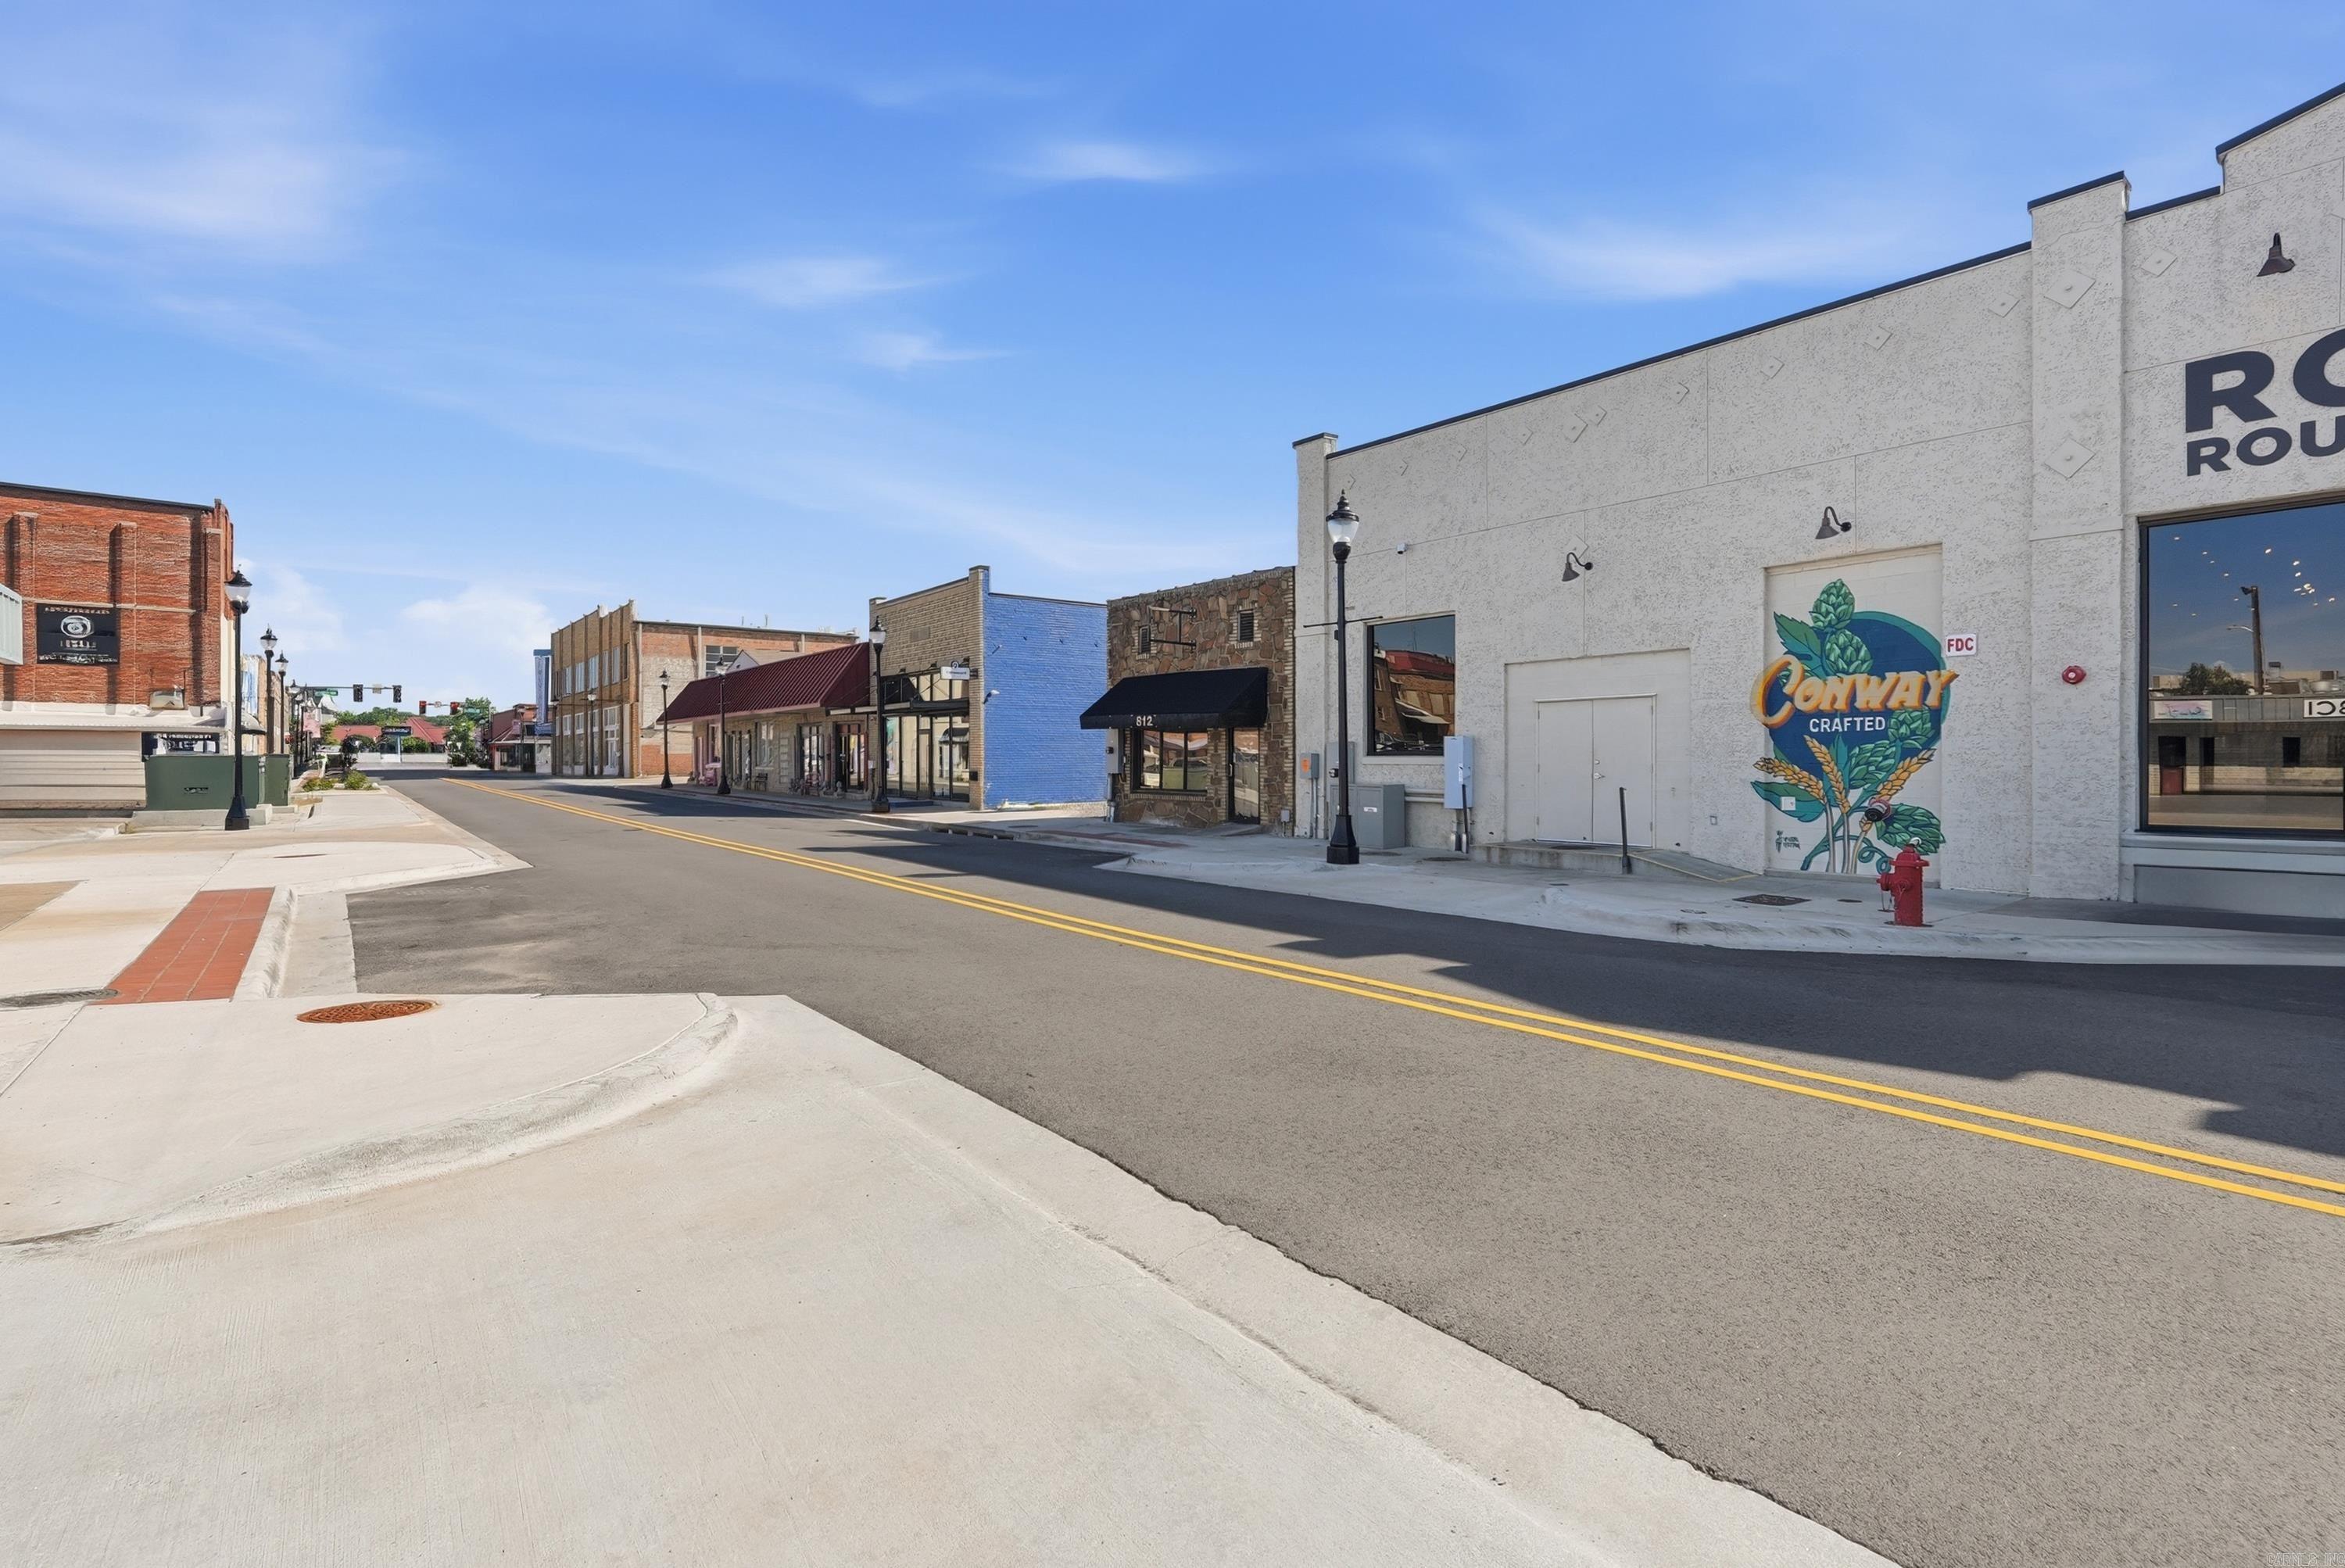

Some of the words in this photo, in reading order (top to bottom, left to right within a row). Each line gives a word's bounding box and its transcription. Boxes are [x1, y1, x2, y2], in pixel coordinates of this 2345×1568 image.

[2187, 415, 2345, 476] ROU
[1947, 637, 1974, 652] FDC
[1750, 654, 1960, 728] CONWAY
[1136, 715, 1154, 726] 812
[1809, 717, 1885, 732] CRAFTED
